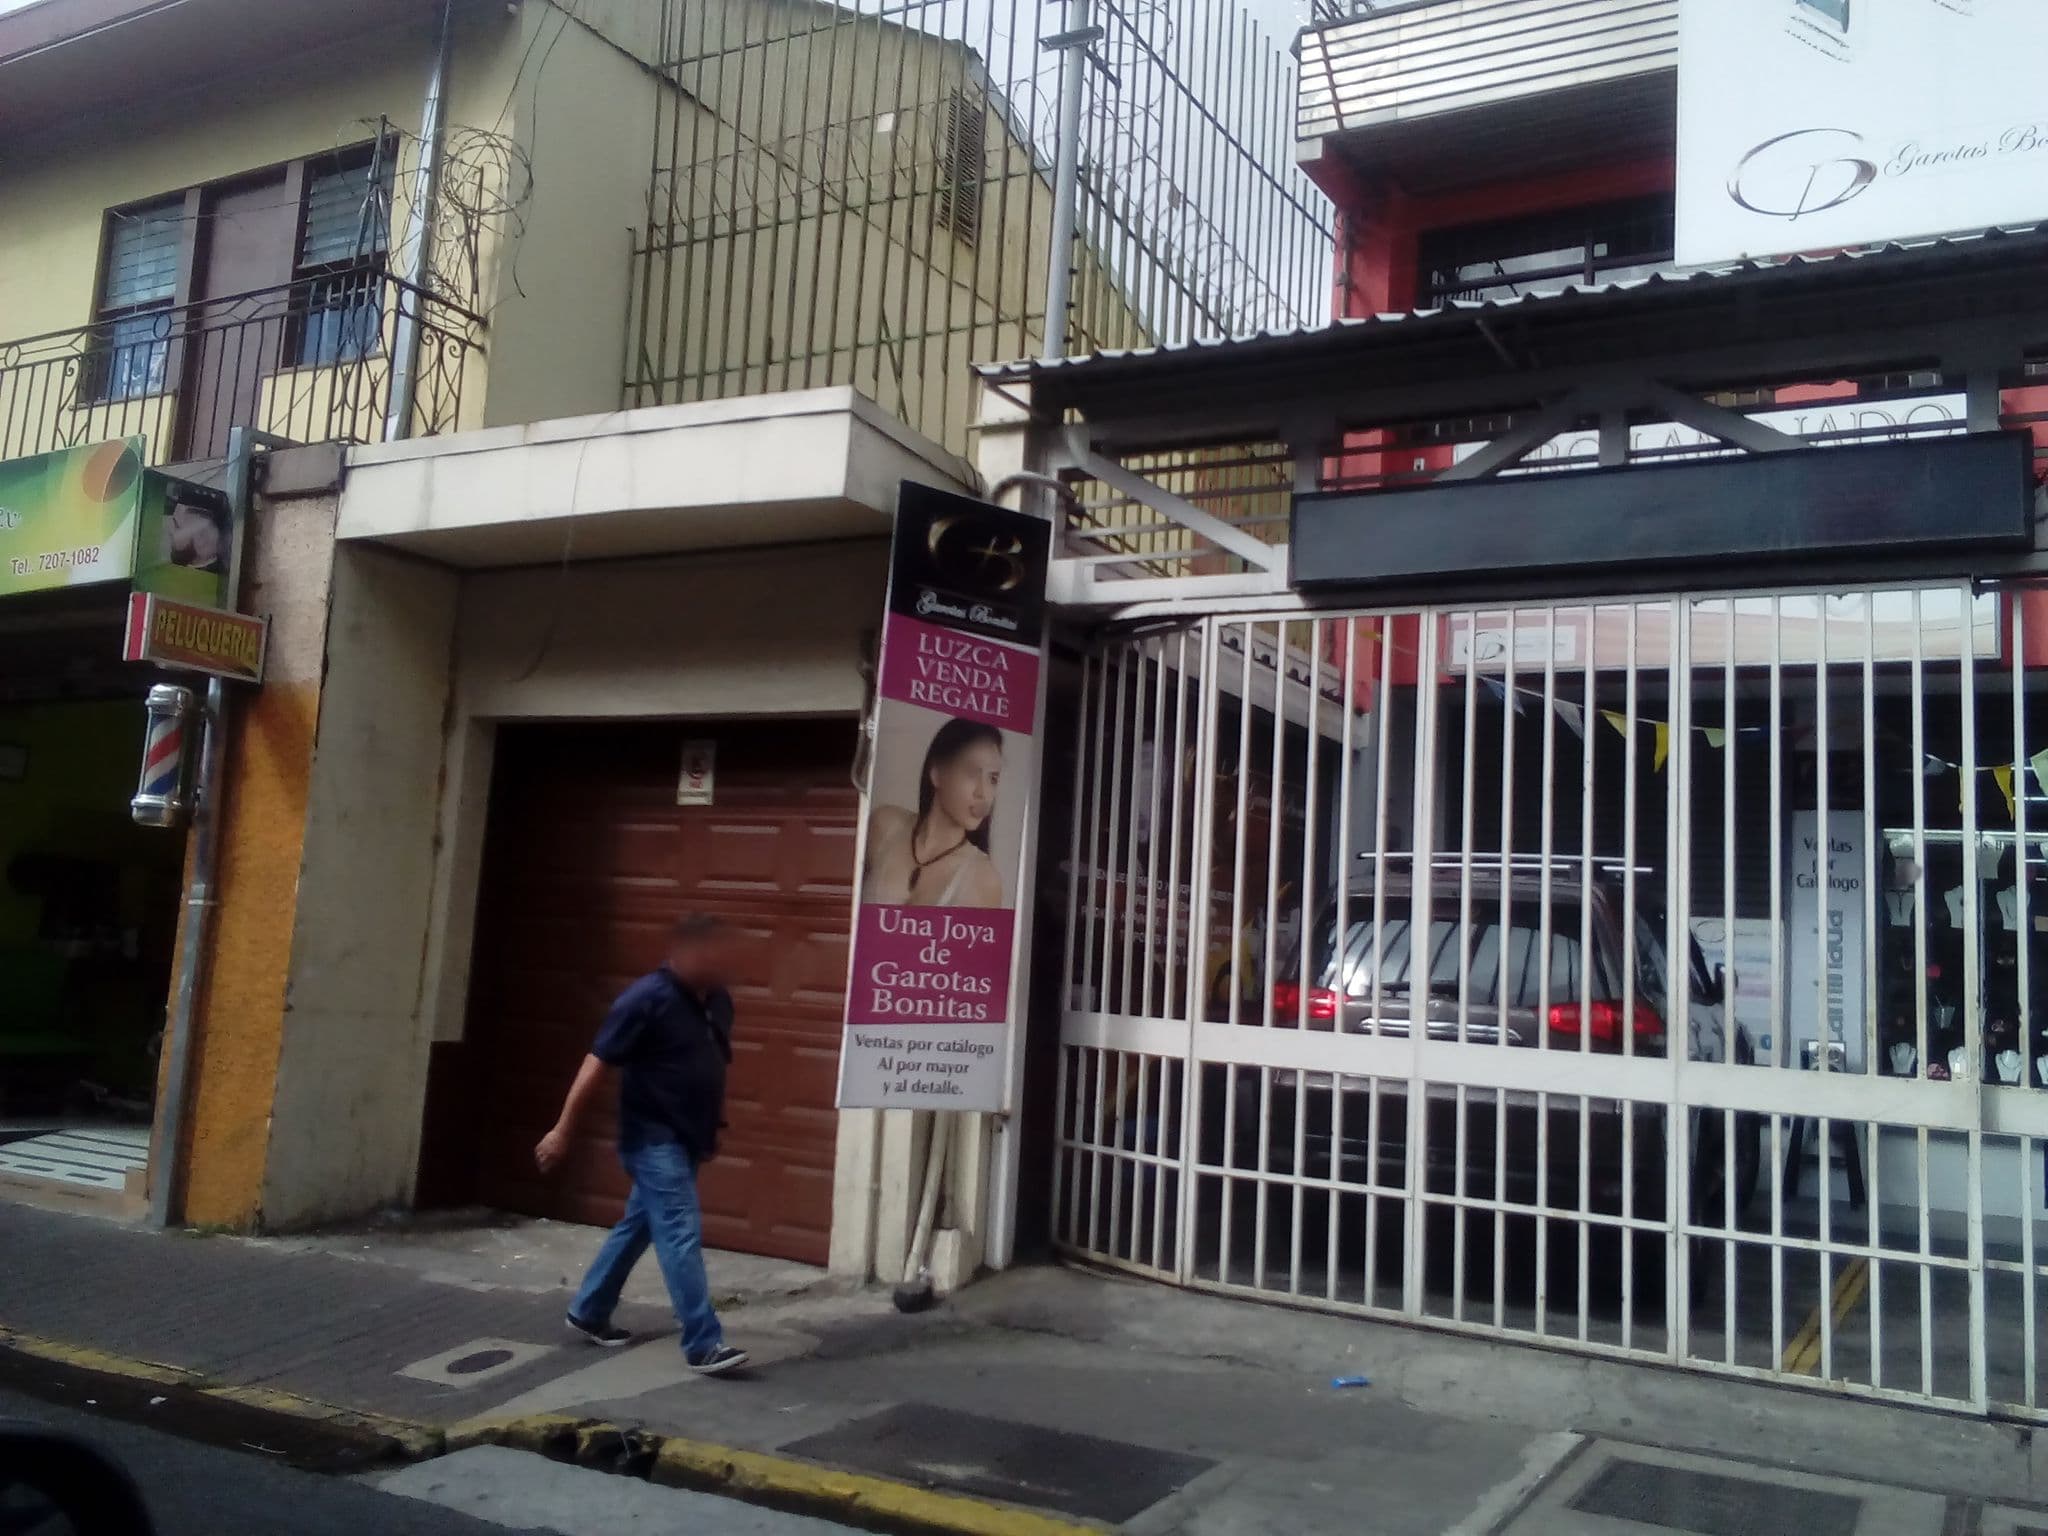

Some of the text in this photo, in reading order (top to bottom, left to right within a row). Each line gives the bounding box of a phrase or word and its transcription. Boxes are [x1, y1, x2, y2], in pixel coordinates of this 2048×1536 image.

[1884, 142, 1988, 177] Garotas
[39, 546, 99, 571] 7207-1082
[155, 606, 257, 664] PELUQUERIA
[919, 632, 1009, 671] LUZCA
[917, 656, 1007, 694] VENDA
[909, 679, 1010, 718] REGALE
[878, 908, 995, 949] Una Joya
[919, 939, 951, 965] de
[871, 961, 992, 995] Garotas
[871, 988, 987, 1019] Bonitas
[855, 1034, 903, 1050] Ventas
[907, 1039, 932, 1054] por
[877, 1057, 970, 1077] Al por mayor
[883, 1079, 964, 1096] y al detalle.
